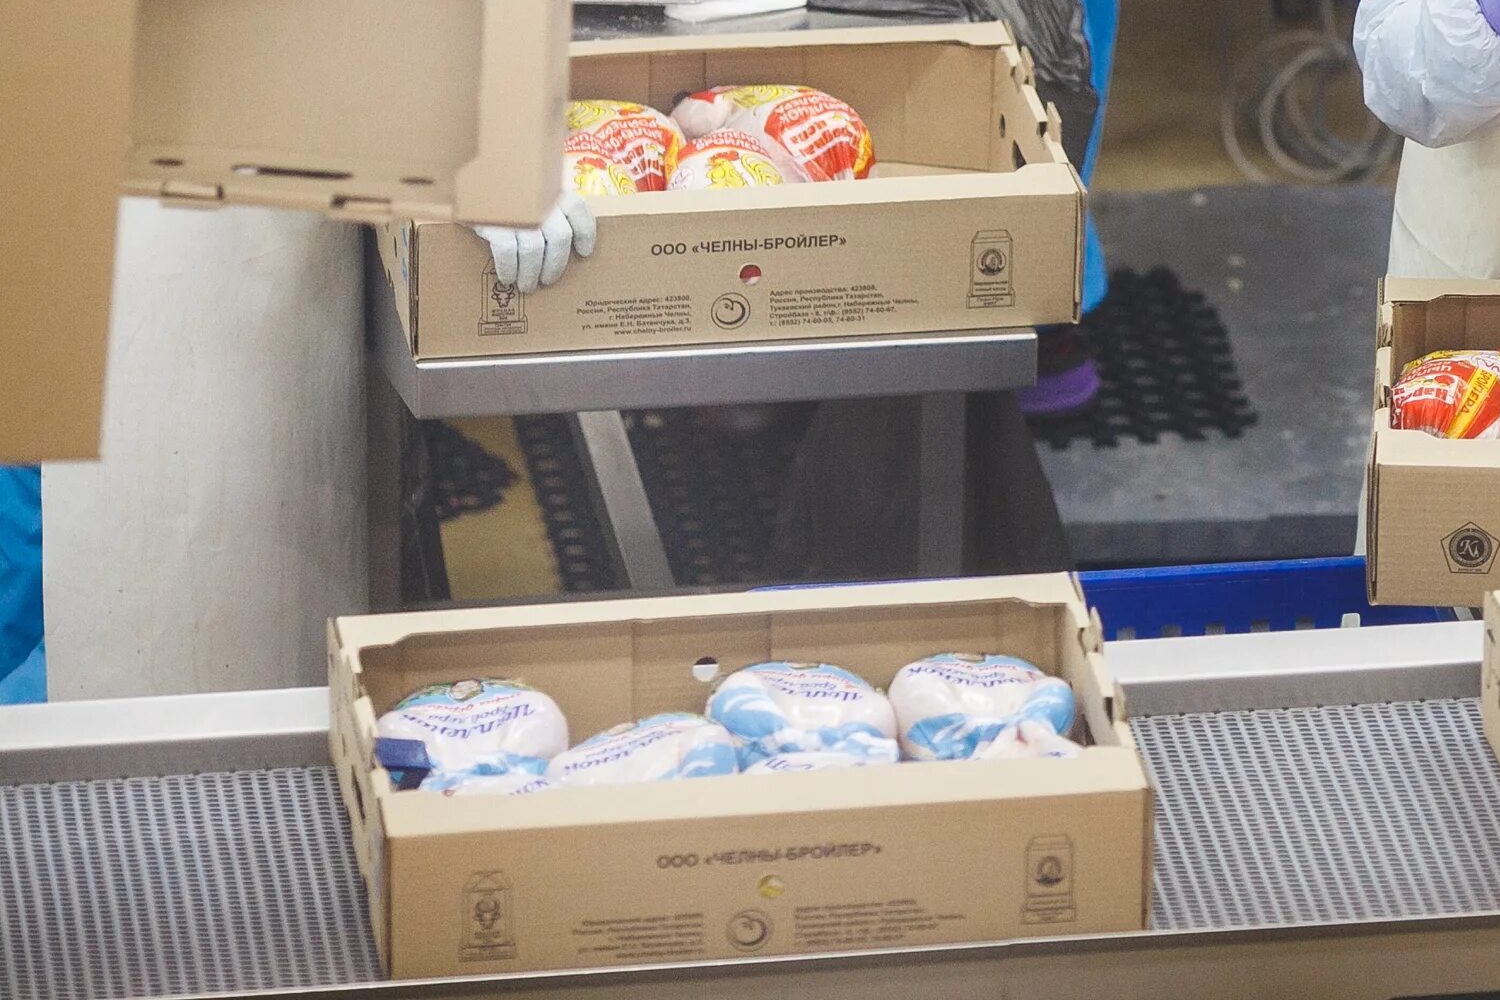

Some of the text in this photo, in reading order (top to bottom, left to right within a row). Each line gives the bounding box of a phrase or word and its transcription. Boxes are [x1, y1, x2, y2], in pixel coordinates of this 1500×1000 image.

[651, 234, 847, 256] ООО «ЧЕЛНЫ-БРОЙЛЕР»
[657, 854, 697, 869] ООО
